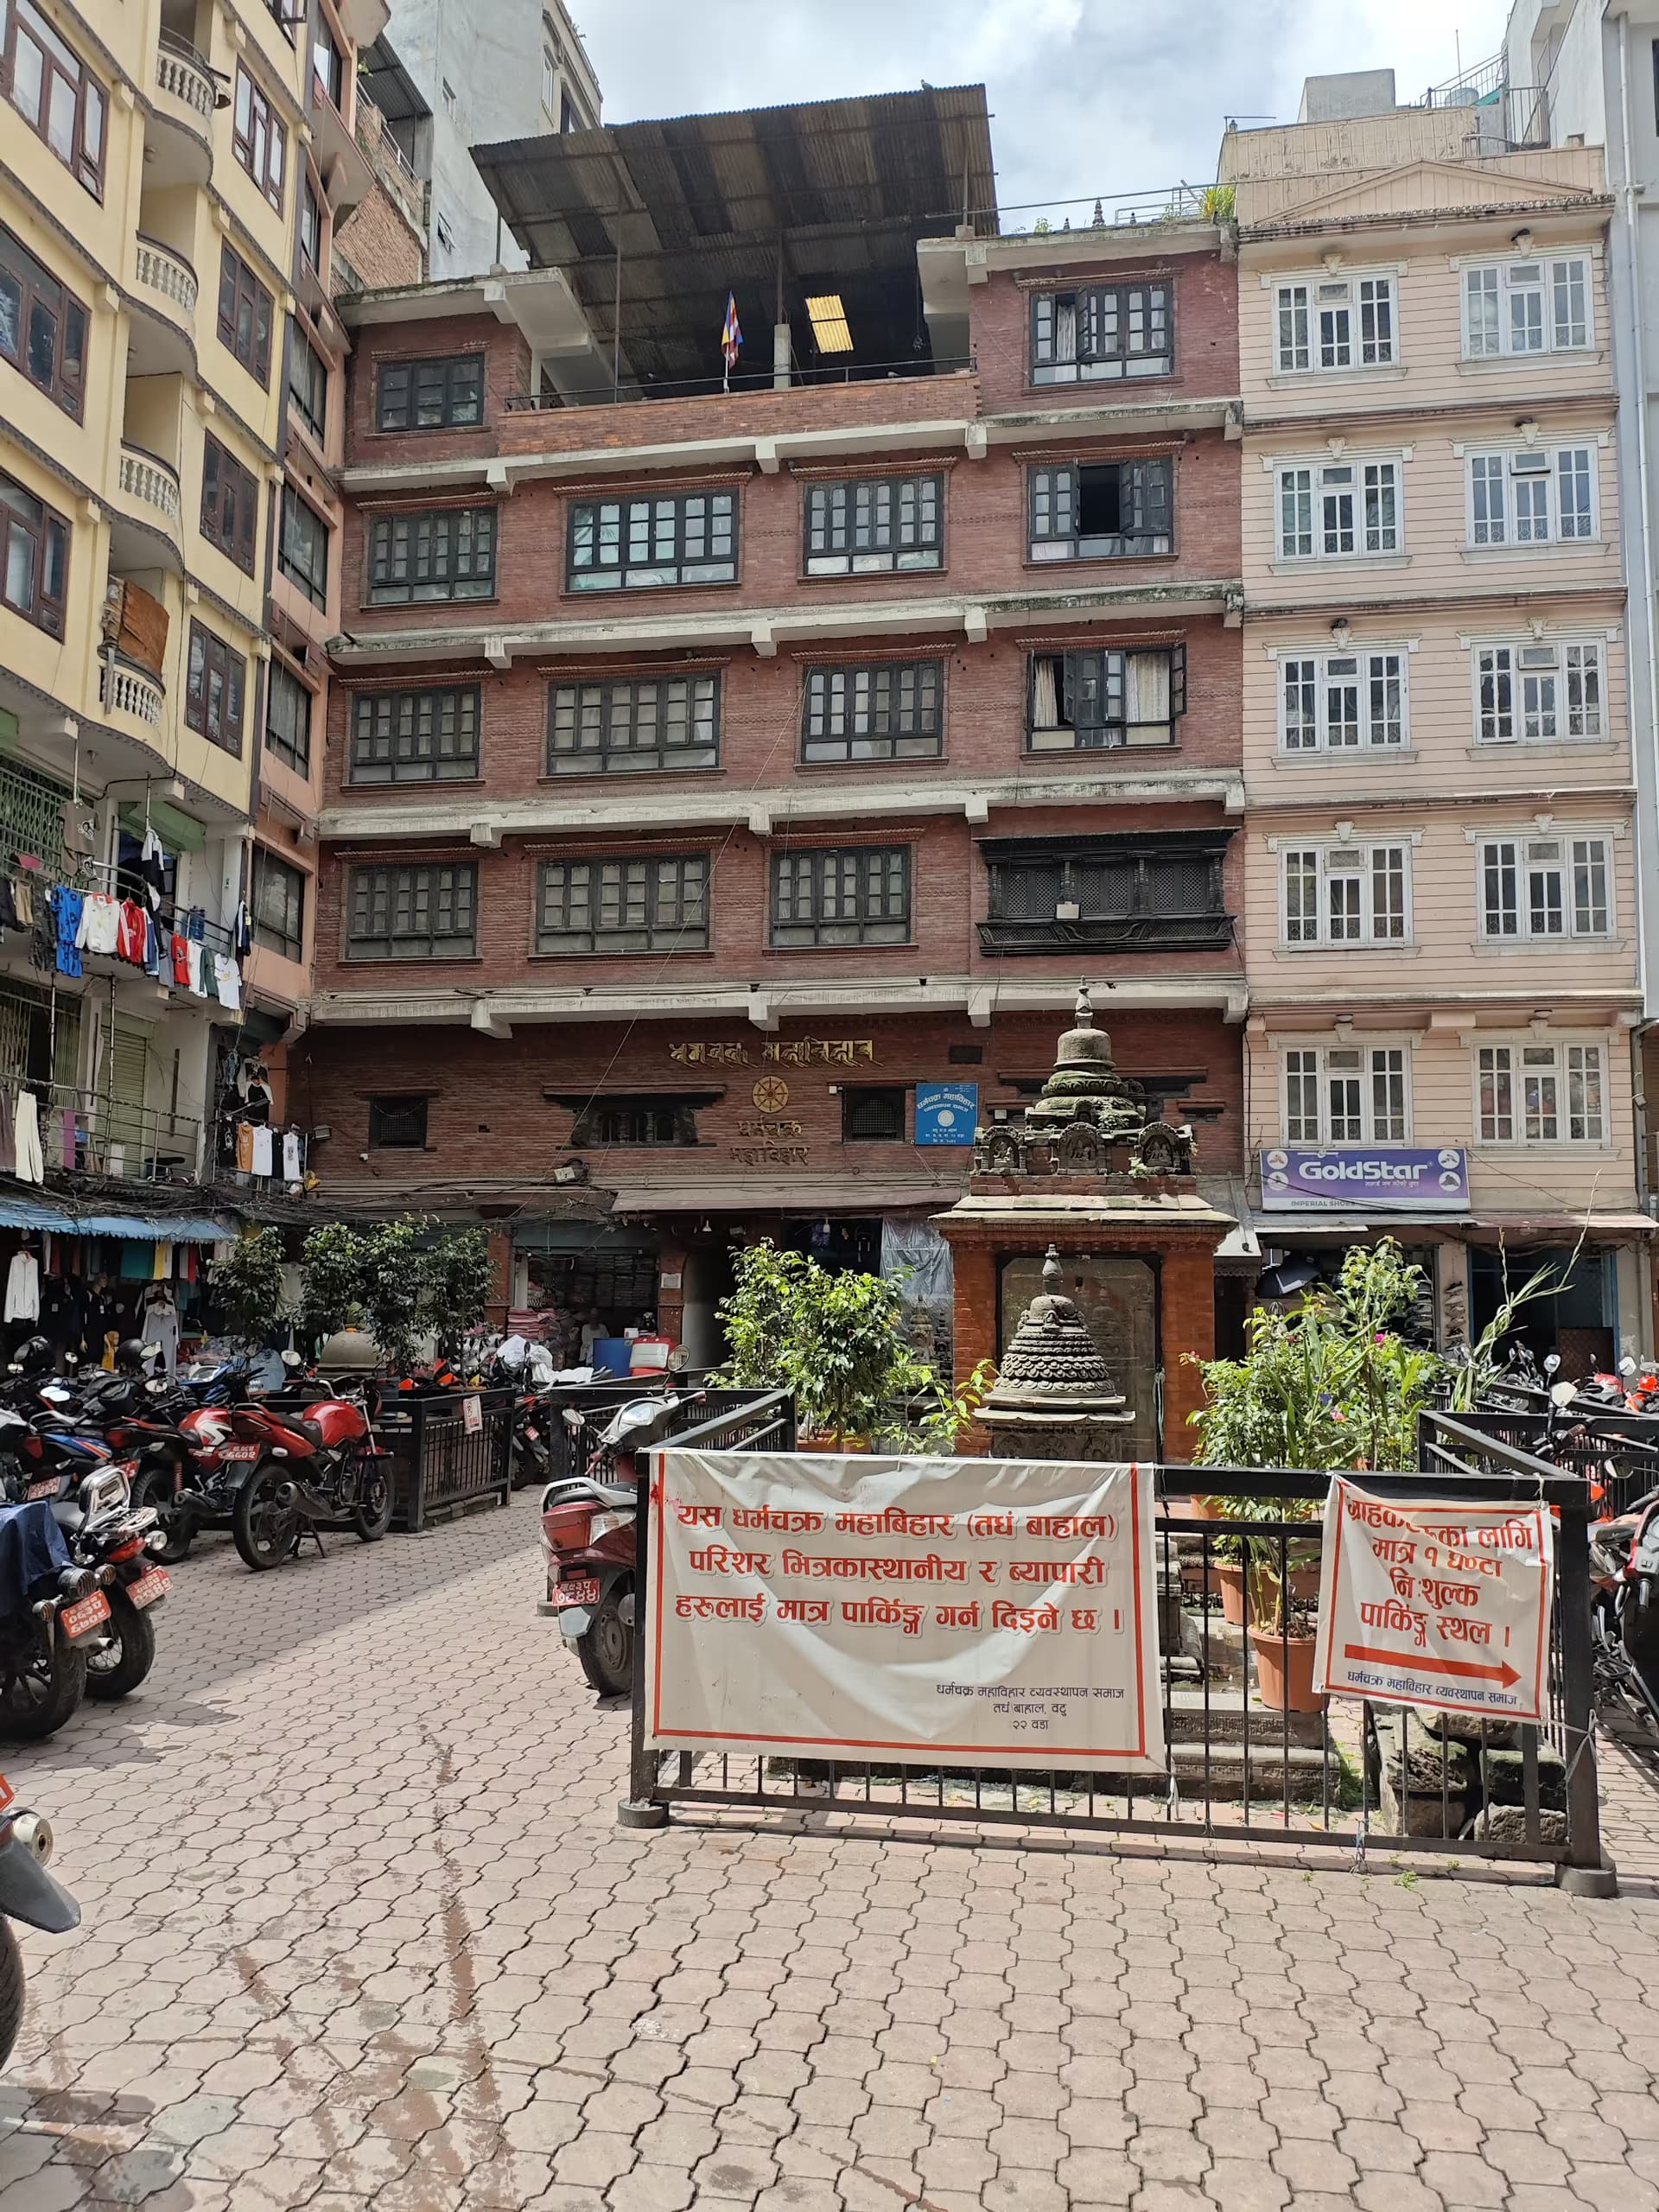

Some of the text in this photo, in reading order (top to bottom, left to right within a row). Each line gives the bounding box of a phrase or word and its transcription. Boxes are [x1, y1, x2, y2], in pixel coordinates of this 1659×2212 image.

[1298, 1160, 1428, 1180] GoldStar
[677, 1505, 722, 1528] यस
[733, 1504, 824, 1533] धर्मचक्र
[836, 1506, 955, 1536] महाबिहार
[1027, 1514, 1116, 1539] बाहाल)
[1476, 1518, 1533, 1549] लागि
[689, 1544, 772, 1574] परिशर
[979, 1561, 996, 1582] र
[1009, 1555, 1105, 1584] ब्यापारी
[1372, 1536, 1503, 1577] मात्र १ घण्टा
[777, 1599, 830, 1622] मात्र
[936, 1600, 980, 1627] गर्न
[992, 1599, 1059, 1632] दिइने
[1071, 1609, 1097, 1630] छ
[1436, 1616, 1493, 1644] स्थल
[936, 1681, 1125, 1699] धर्मचक्र महाविहार व्यवस्थापन समाज
[1347, 1670, 1518, 1705] धर्मचक्र महाविहार व्यवस्थापन समाज
[1012, 1719, 1049, 1730] २२ वडा
